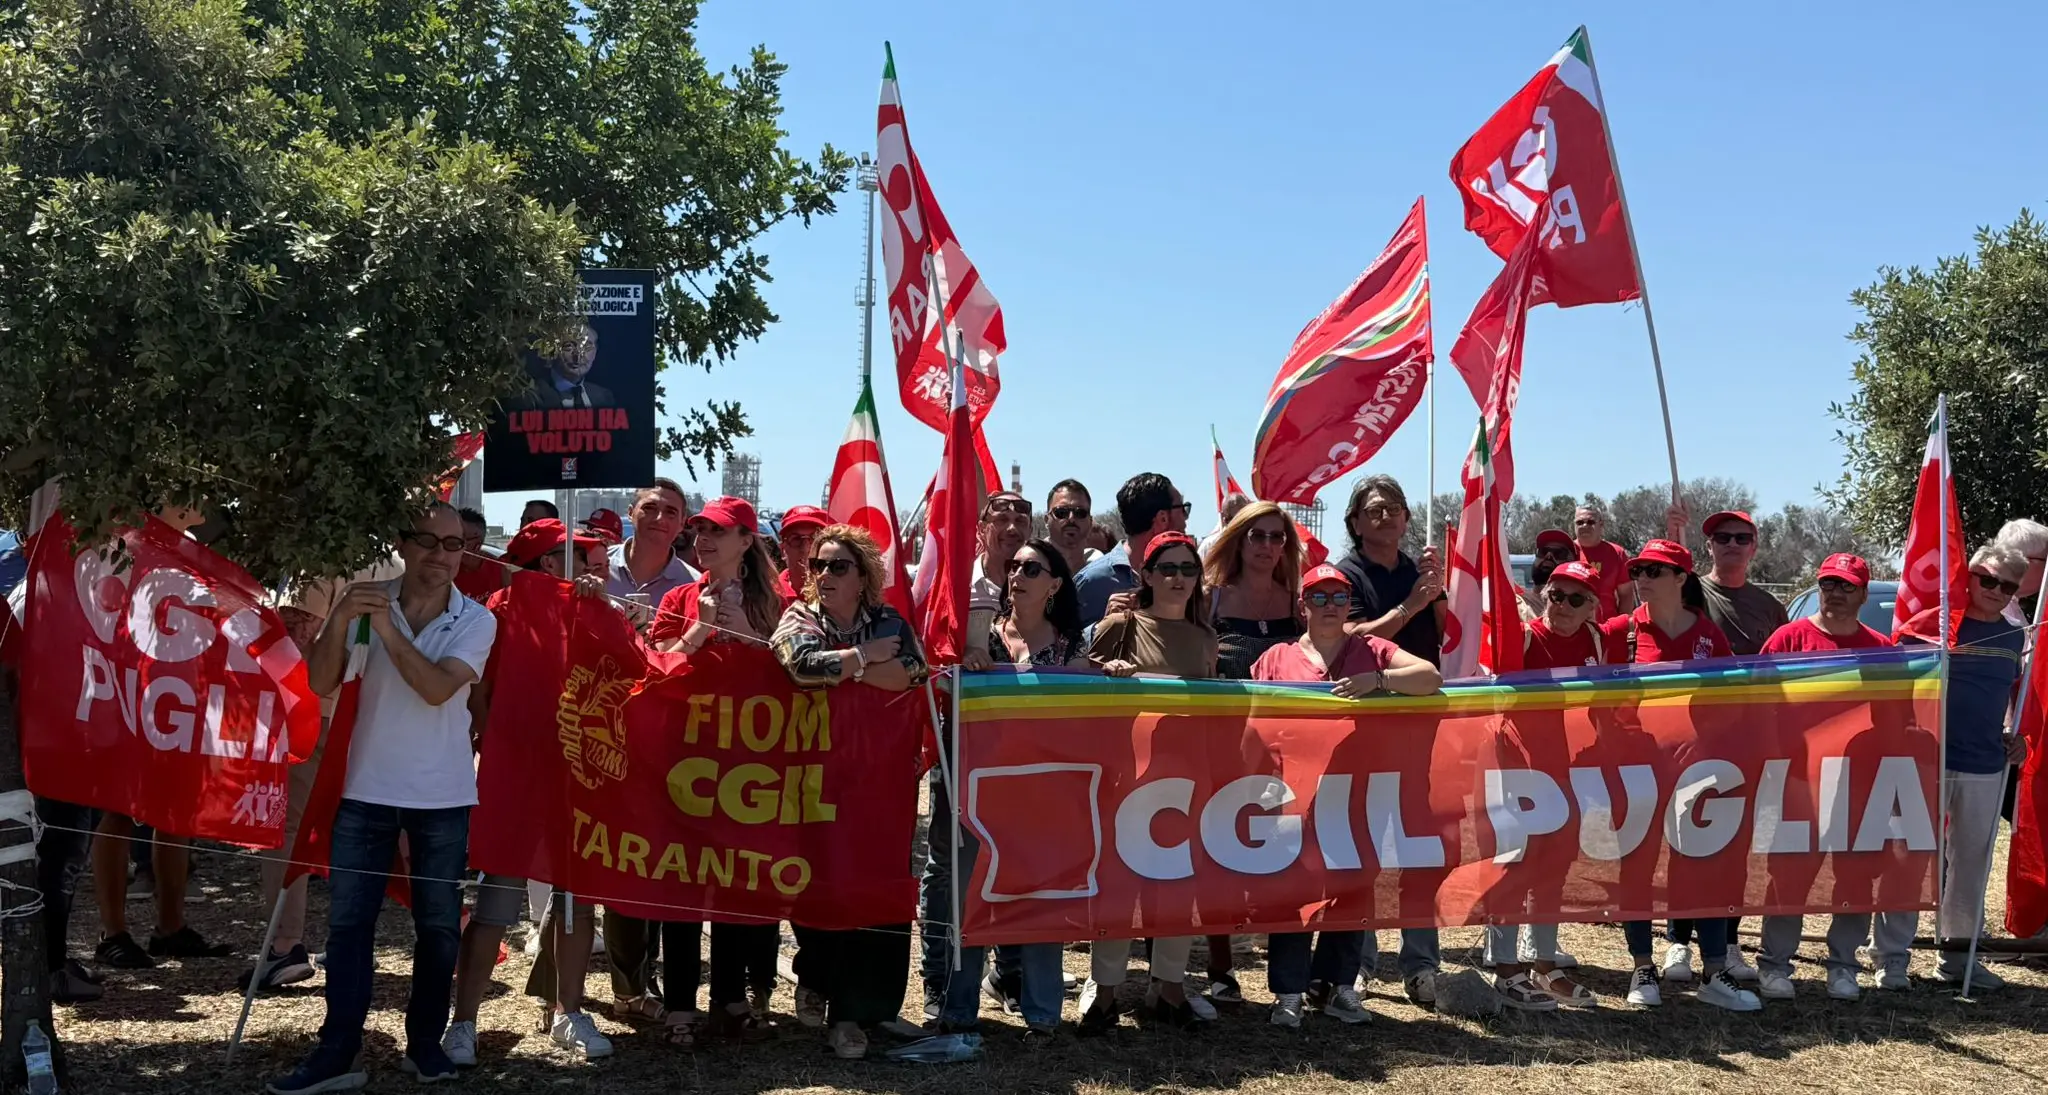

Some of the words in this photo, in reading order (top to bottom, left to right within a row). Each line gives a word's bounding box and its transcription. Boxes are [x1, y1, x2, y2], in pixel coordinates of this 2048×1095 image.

[577, 286, 631, 299] UPAZIONE
[633, 287, 641, 299] E
[584, 301, 635, 313] OLOGICA
[509, 410, 543, 432] LUI
[547, 409, 595, 431] NON
[599, 408, 630, 430] HA
[526, 430, 612, 453] VOLUTO
[683, 690, 831, 752] FIOM
[666, 757, 837, 825] CGIL
[1114, 771, 1445, 880] CGIL
[1484, 756, 1937, 864] PUGLIA
[573, 807, 812, 895] TARANTO
